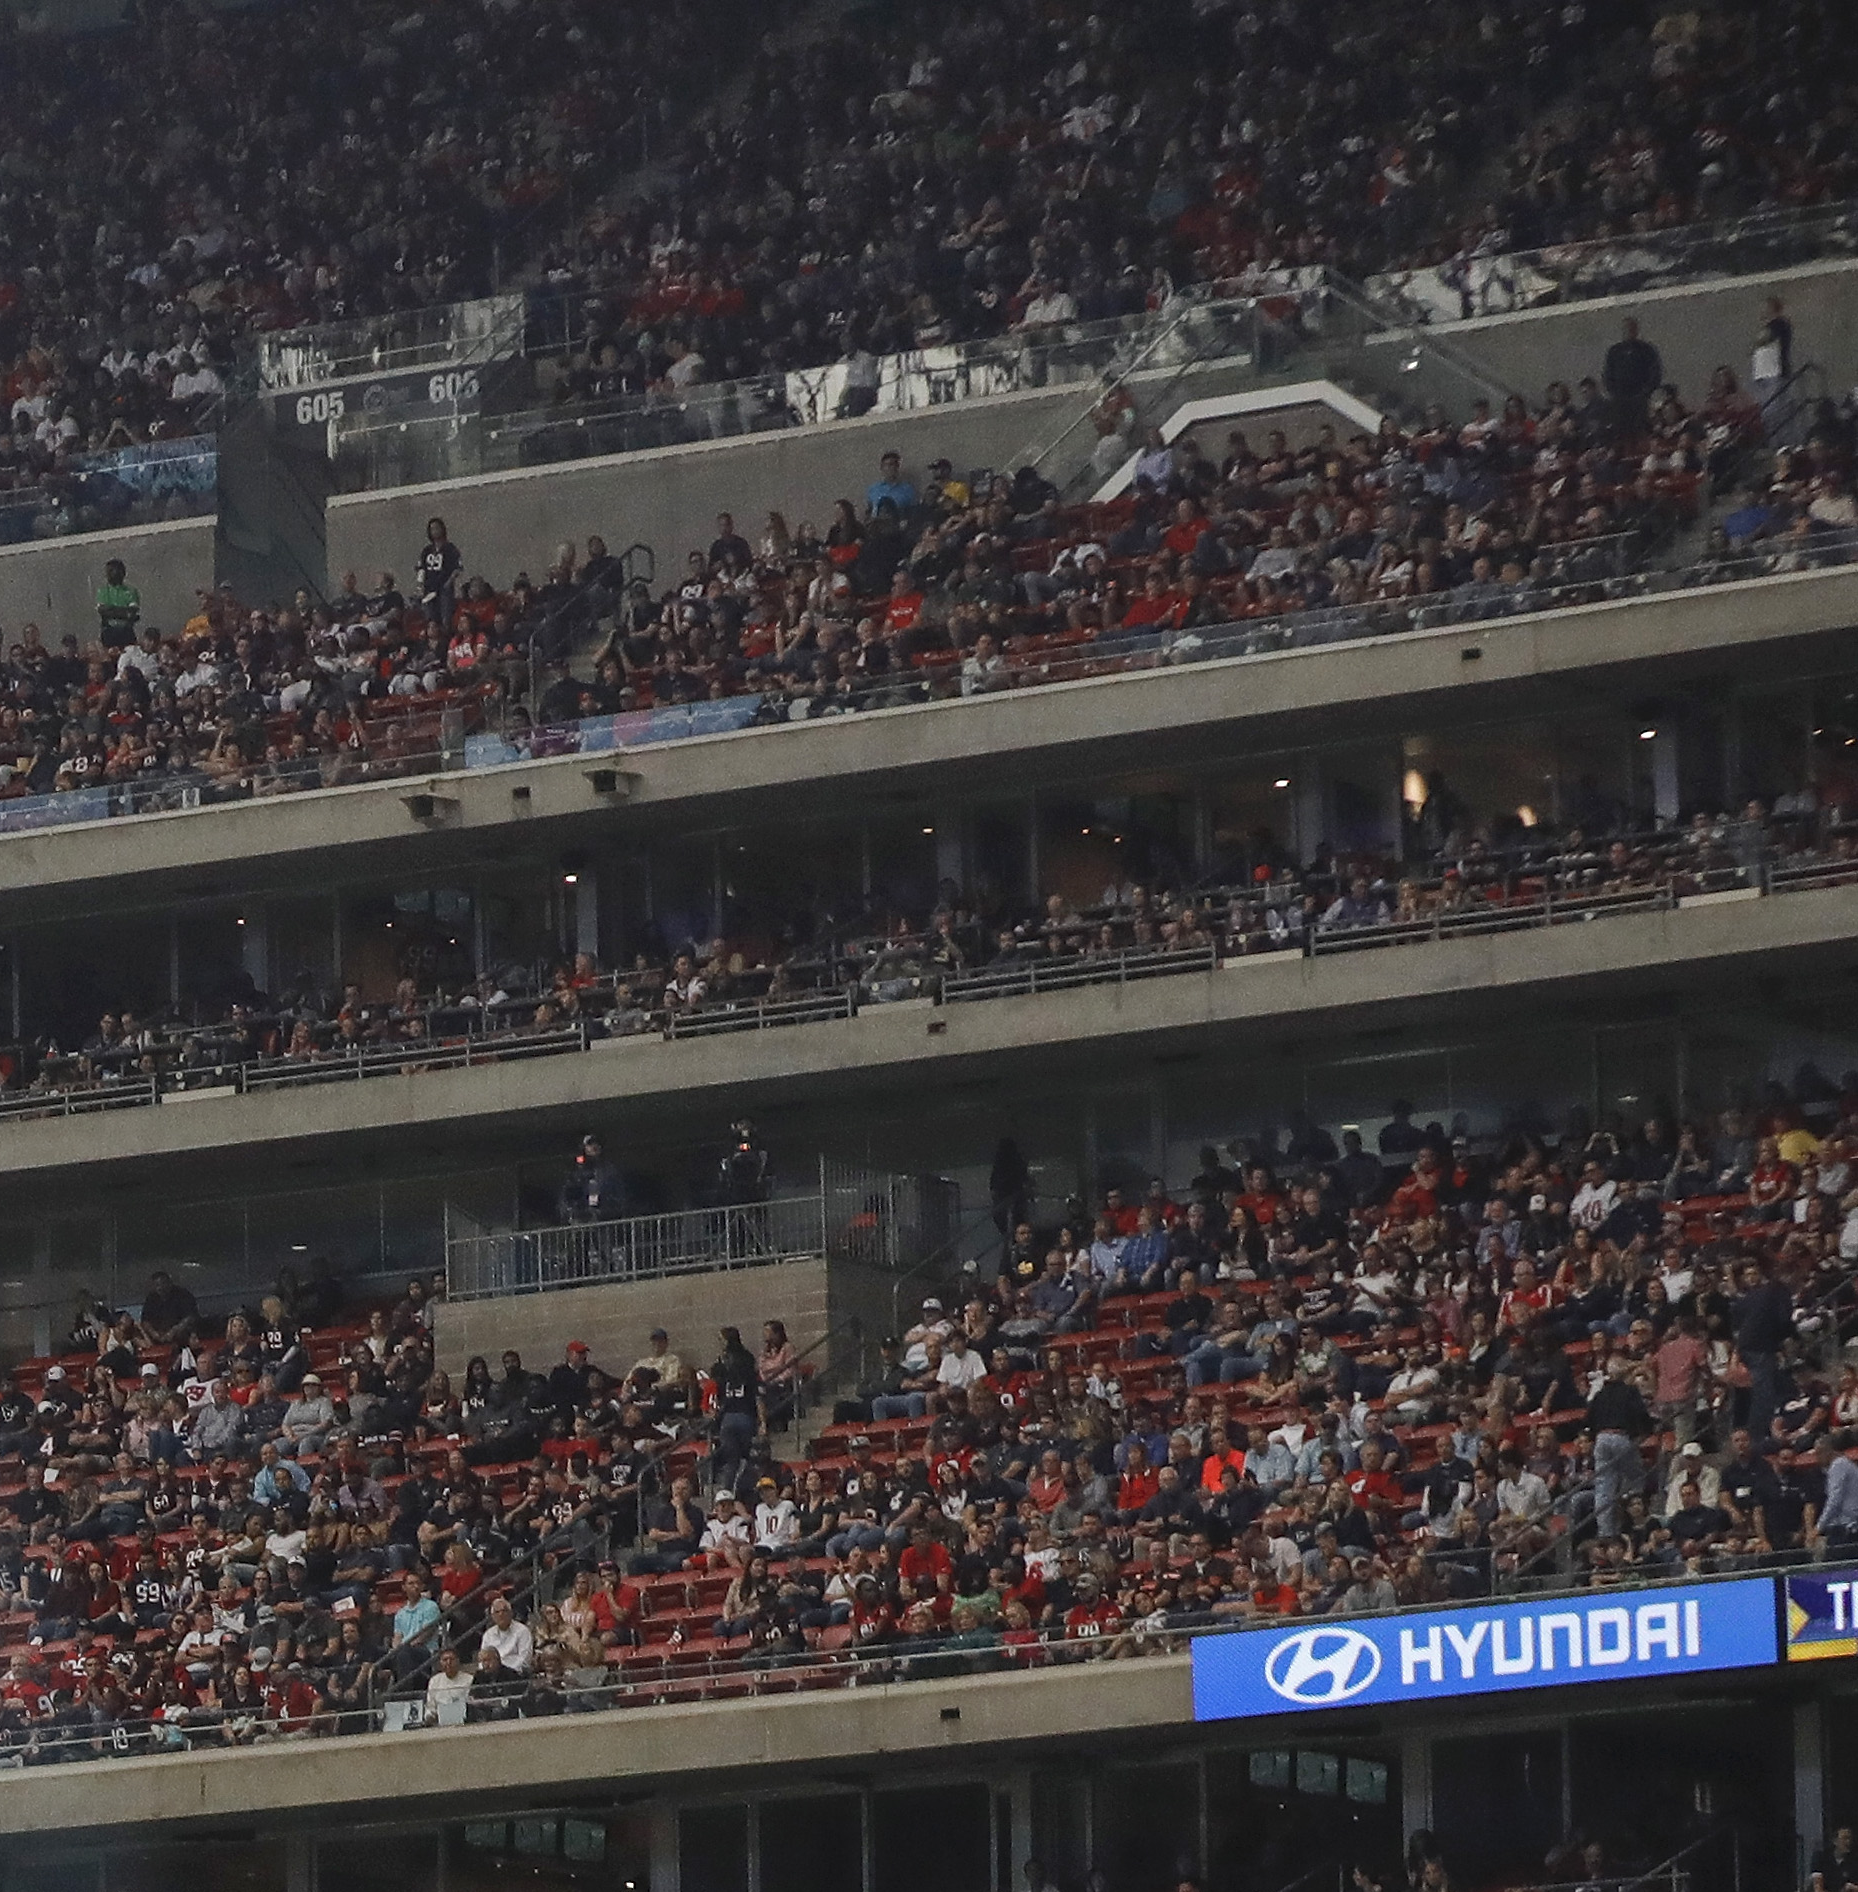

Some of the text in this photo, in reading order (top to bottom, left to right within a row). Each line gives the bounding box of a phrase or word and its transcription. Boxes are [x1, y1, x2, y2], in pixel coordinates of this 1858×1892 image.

[296, 395, 344, 425] 605
[40, 1438, 54, 1457] 4
[1400, 1601, 1700, 1686] HYUNDAI
